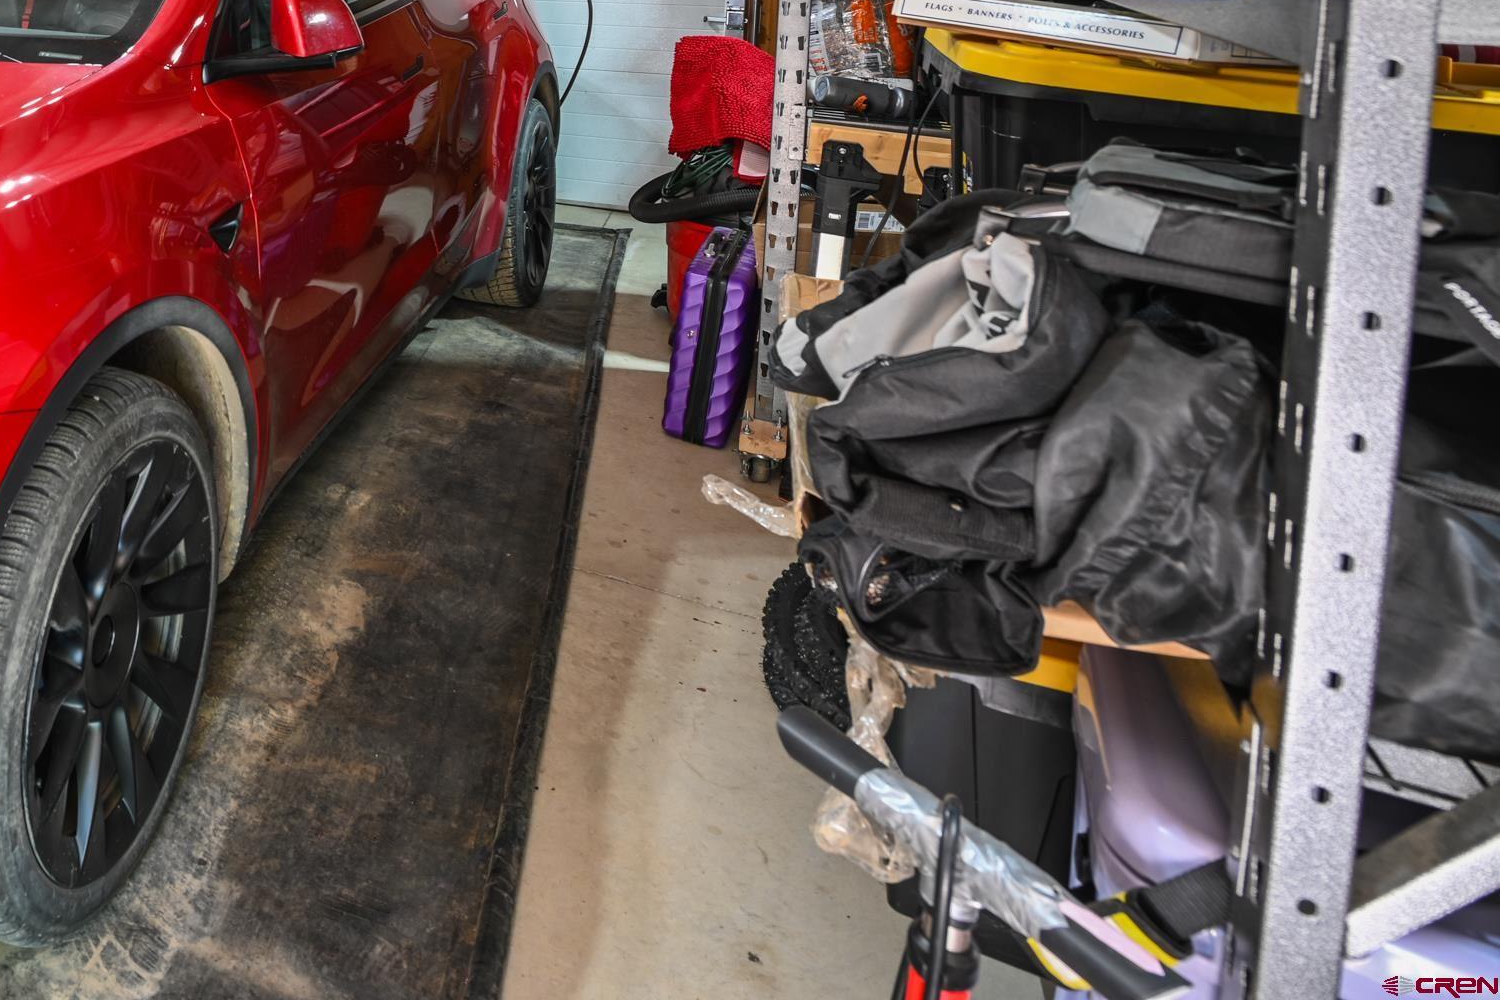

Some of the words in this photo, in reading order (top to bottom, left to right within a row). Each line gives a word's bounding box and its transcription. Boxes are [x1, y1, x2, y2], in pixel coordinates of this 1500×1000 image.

[924, 2, 954, 12] FLAGS
[967, 8, 1013, 20] BANNERS
[1063, 21, 1071, 29] &
[1075, 22, 1145, 40] ACCESSORIES
